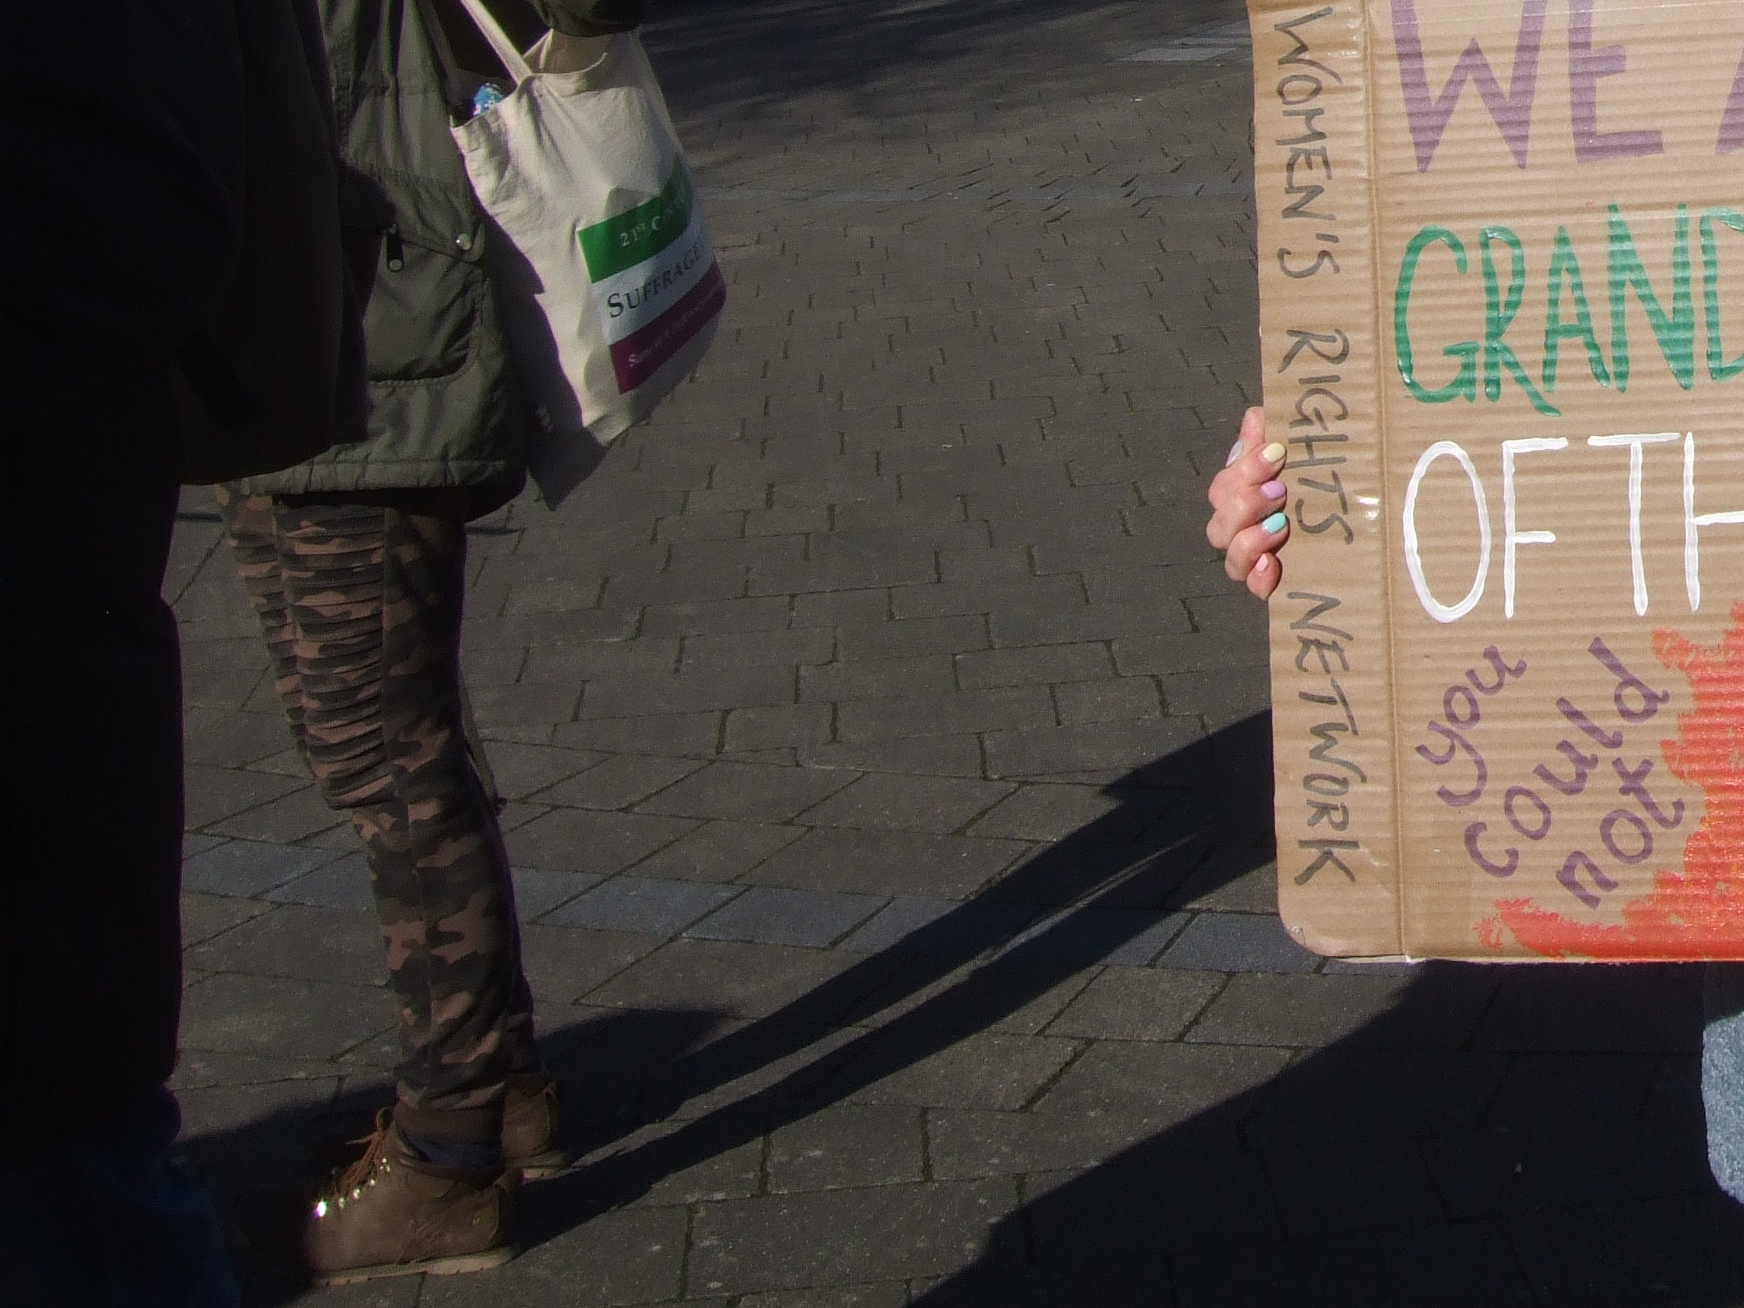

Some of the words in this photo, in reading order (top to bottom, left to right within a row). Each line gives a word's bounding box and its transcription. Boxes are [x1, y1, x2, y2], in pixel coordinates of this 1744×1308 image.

[1273, 6, 1342, 281] WOMEN'S
[1277, 329, 1354, 546] RIGHTS
[1403, 438, 1569, 624] OF
[1286, 590, 1368, 888] NETWORK
[1415, 645, 1527, 807] you
[1463, 637, 1670, 878] could
[1555, 756, 1685, 910] not
